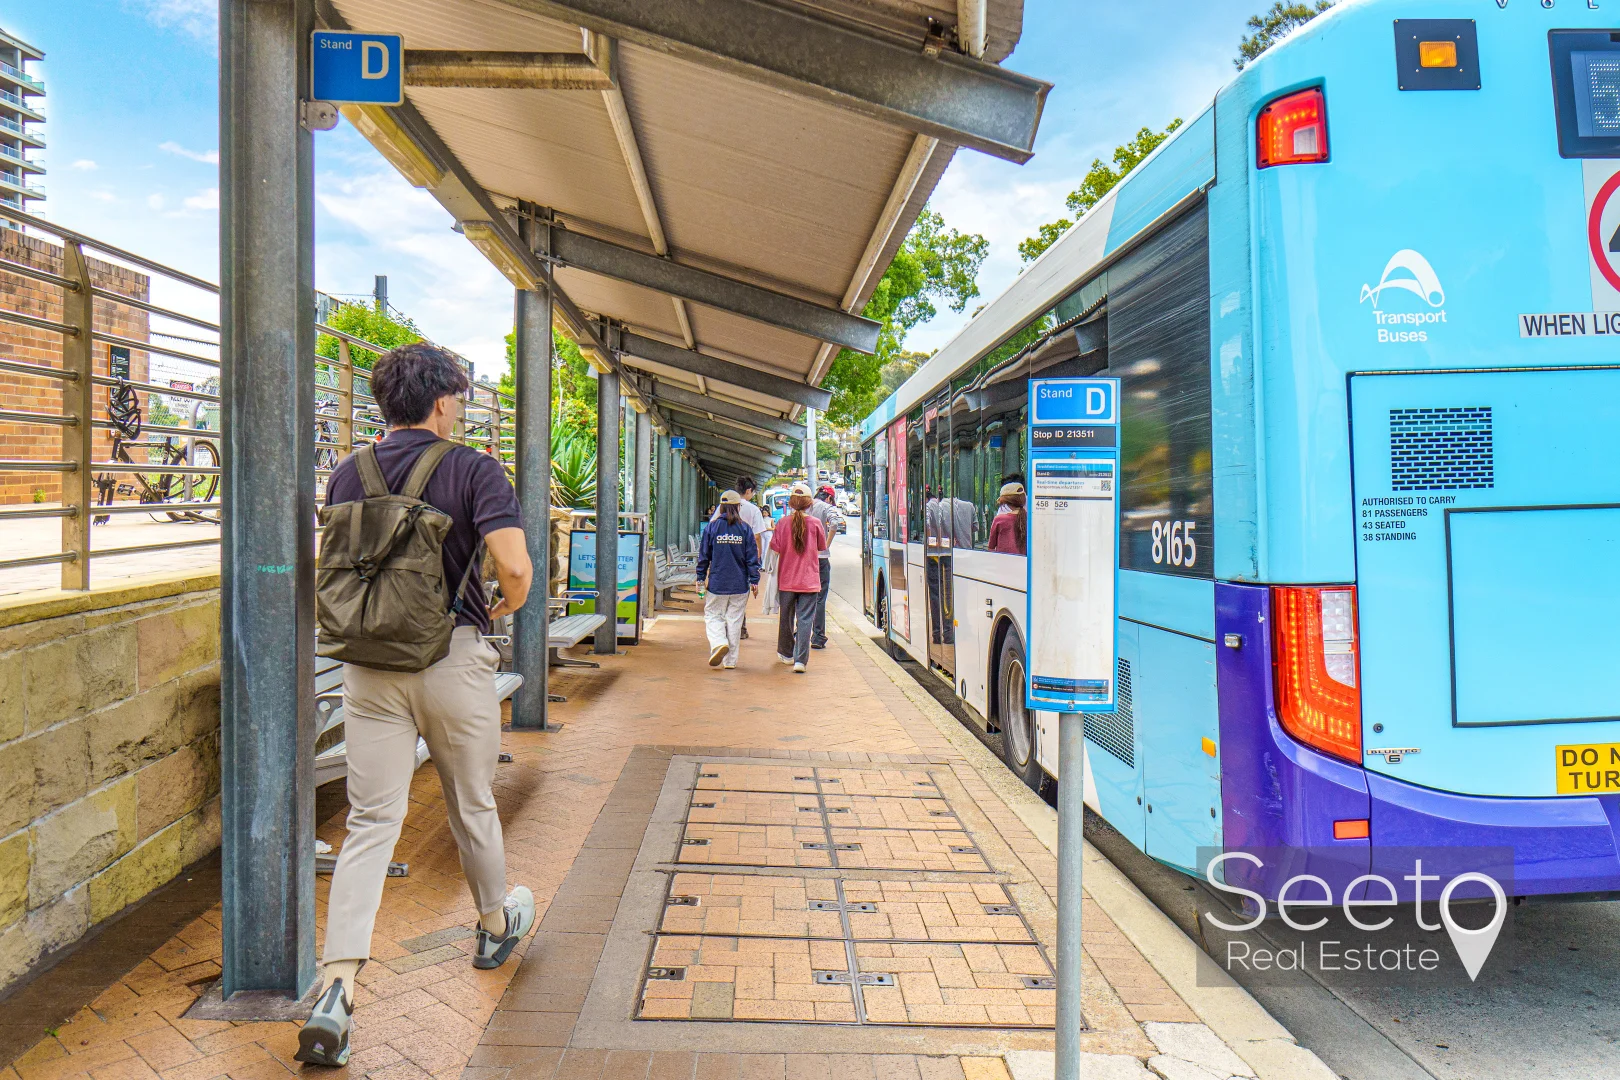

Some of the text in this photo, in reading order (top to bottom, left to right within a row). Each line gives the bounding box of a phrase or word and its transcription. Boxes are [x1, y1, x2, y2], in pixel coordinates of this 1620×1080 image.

[320, 39, 389, 79] Stand D
[1373, 310, 1447, 326] Transport
[1523, 314, 1585, 336] WHEN
[1377, 329, 1427, 343] Buses
[1040, 387, 1105, 415] Stand D
[1033, 430, 1094, 440] Stop ID 213511
[678, 438, 684, 446] C
[1362, 496, 1456, 506] AUTHORISED TO CARRY
[1362, 508, 1428, 518] 81 PASSENGERS
[1362, 520, 1406, 529] 43 SEATED
[716, 533, 743, 541] adidas
[1363, 532, 1417, 541] 38 STANDING
[1151, 520, 1196, 568] 8165
[1389, 754, 1400, 762] 6
[1562, 748, 1598, 766] DO
[1569, 770, 1620, 789] TUR
